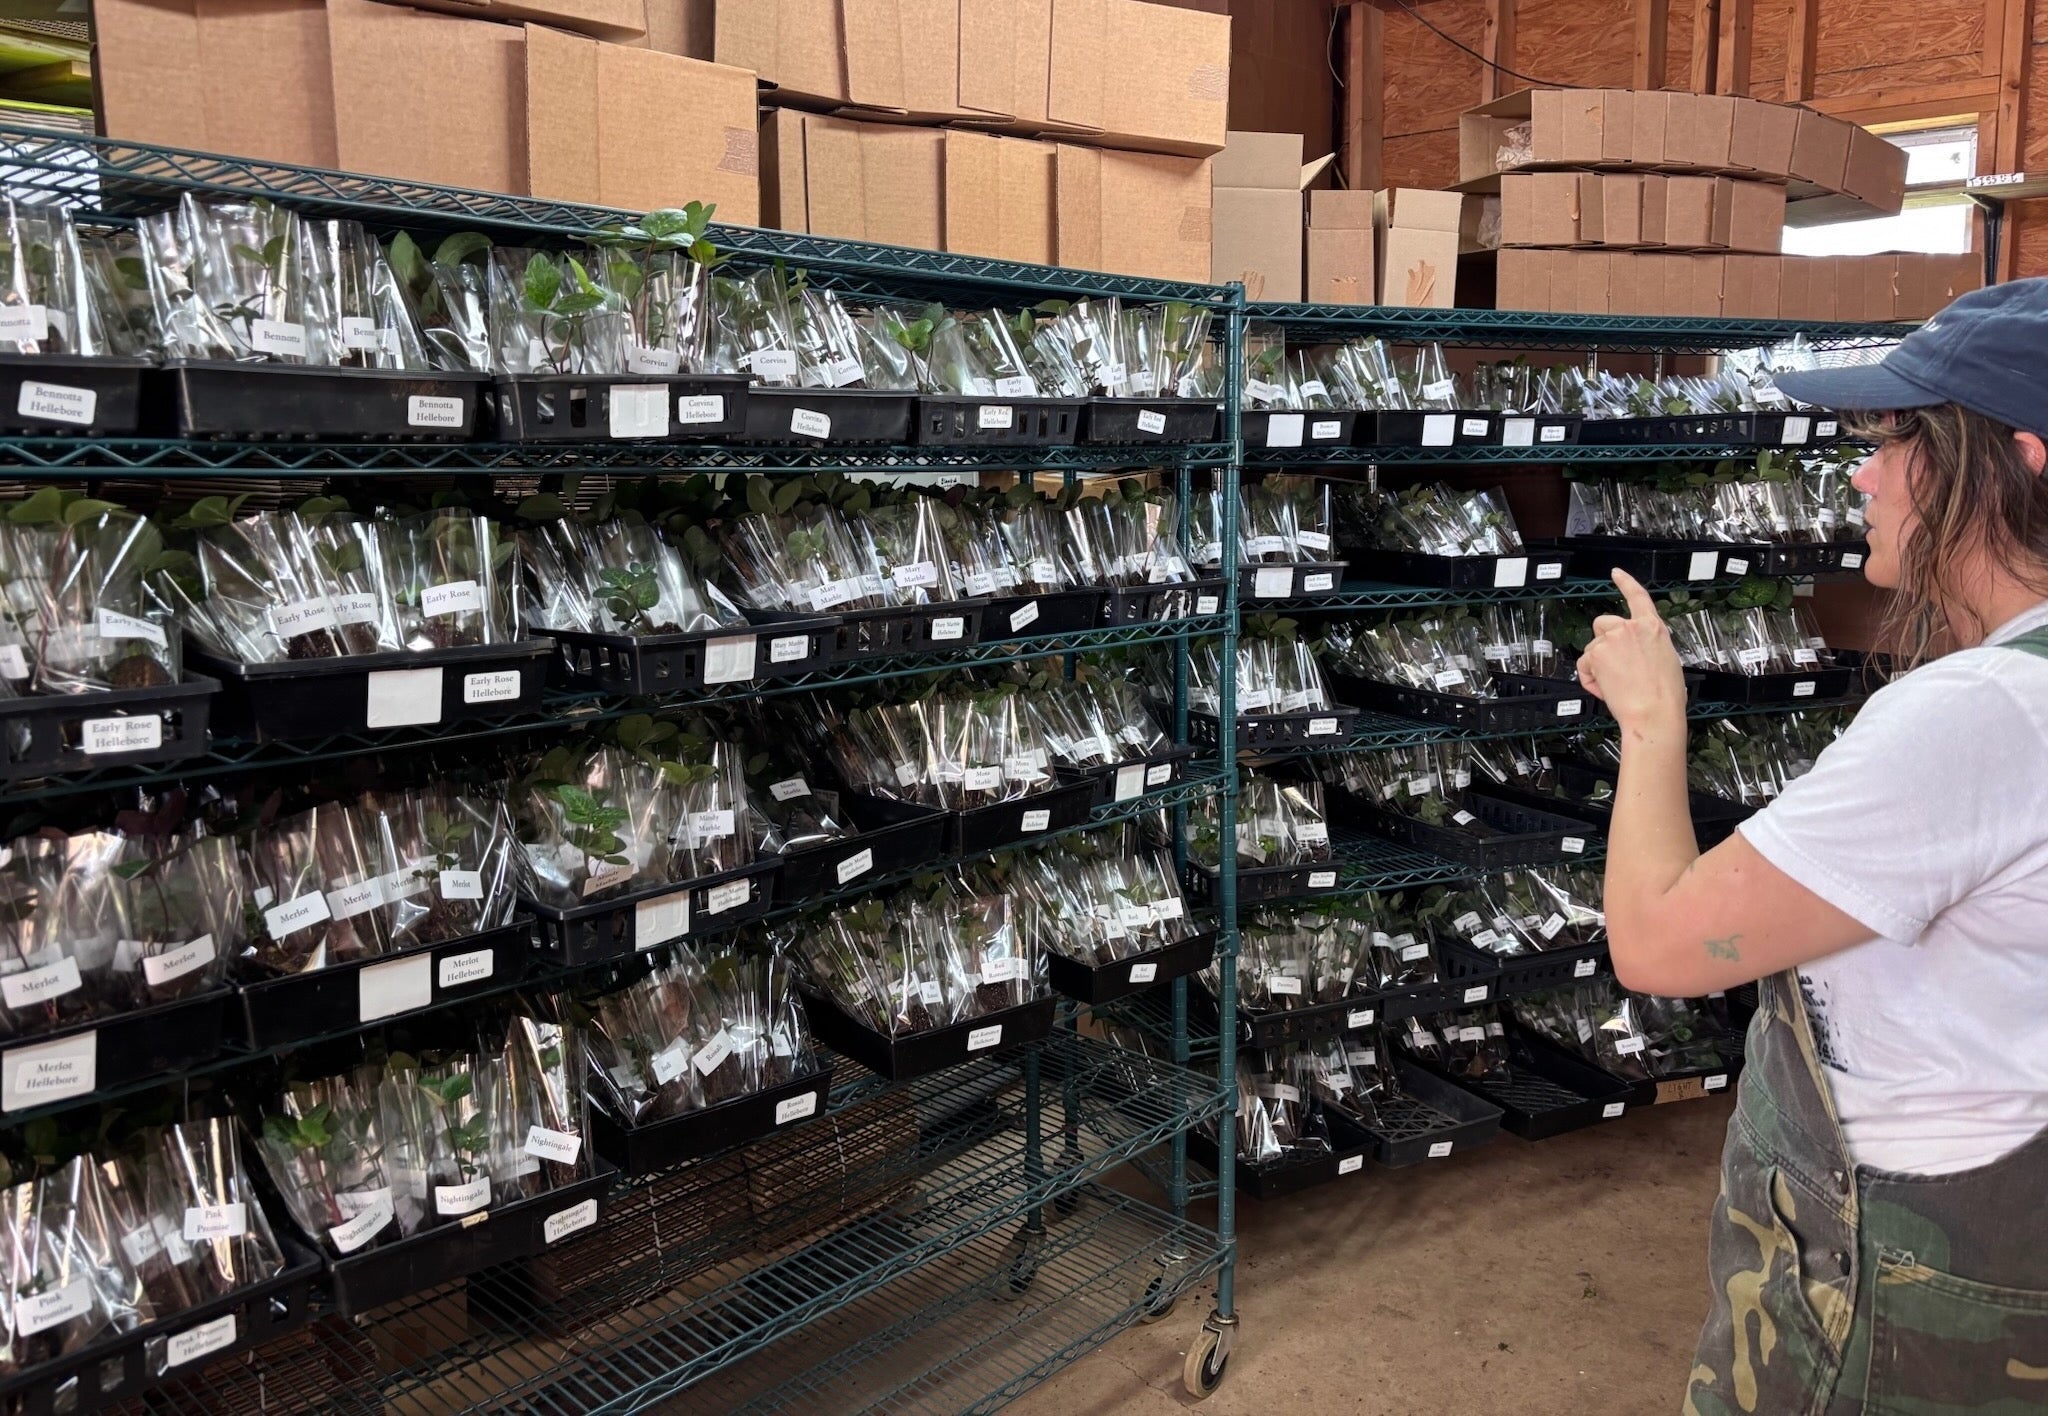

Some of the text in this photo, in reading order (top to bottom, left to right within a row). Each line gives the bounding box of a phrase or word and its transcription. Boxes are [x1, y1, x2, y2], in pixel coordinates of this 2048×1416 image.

[0, 316, 31, 327] nnotta
[263, 329, 301, 344] Bennotta
[353, 327, 375, 337] Benn
[639, 355, 668, 368] Corvina
[760, 357, 787, 365] Corvina
[35, 386, 82, 403] Bennotta
[30, 401, 84, 418] Hellebore
[418, 400, 454, 410] Bennotta
[688, 399, 714, 408] Corvina
[416, 412, 455, 423] Hellebore
[685, 411, 717, 420] Hellebore
[801, 412, 823, 424] Corvina
[983, 417, 1008, 425] Hellebore
[797, 423, 823, 434] Hellebore
[425, 588, 471, 605] Early Rose
[334, 601, 372, 614] arly Rose
[105, 614, 132, 628] Early
[277, 605, 326, 627] Early Rose
[470, 674, 514, 687] Early Rose
[472, 687, 512, 699] Hellebore
[92, 720, 152, 735] Early Rose
[95, 735, 150, 749] Hellebore
[699, 824, 721, 832] Marble
[391, 876, 416, 890] Merlot
[452, 880, 471, 888] Merlot
[343, 890, 372, 906] Merlot
[280, 906, 309, 923] Merlot
[163, 951, 196, 970] Merlot
[453, 956, 479, 968] Merlot
[447, 966, 485, 983] Hellebore
[22, 974, 60, 992] Merlot
[37, 1061, 73, 1073] Merlot
[26, 1074, 78, 1089] Hellebore
[781, 1107, 808, 1120] Hellebore
[530, 1134, 573, 1152] Nightingale
[440, 1188, 485, 1204] Nightingale
[204, 1209, 222, 1219] Pink
[549, 1204, 590, 1229] Nightingale
[196, 1222, 230, 1233] Promise
[337, 1210, 383, 1244] Nightingale
[553, 1214, 587, 1236] Hellebore
[39, 1291, 62, 1307] Pink
[33, 1304, 73, 1325] Promise
[176, 1321, 229, 1347] Pink Promise
[183, 1335, 223, 1356] Hellebore
